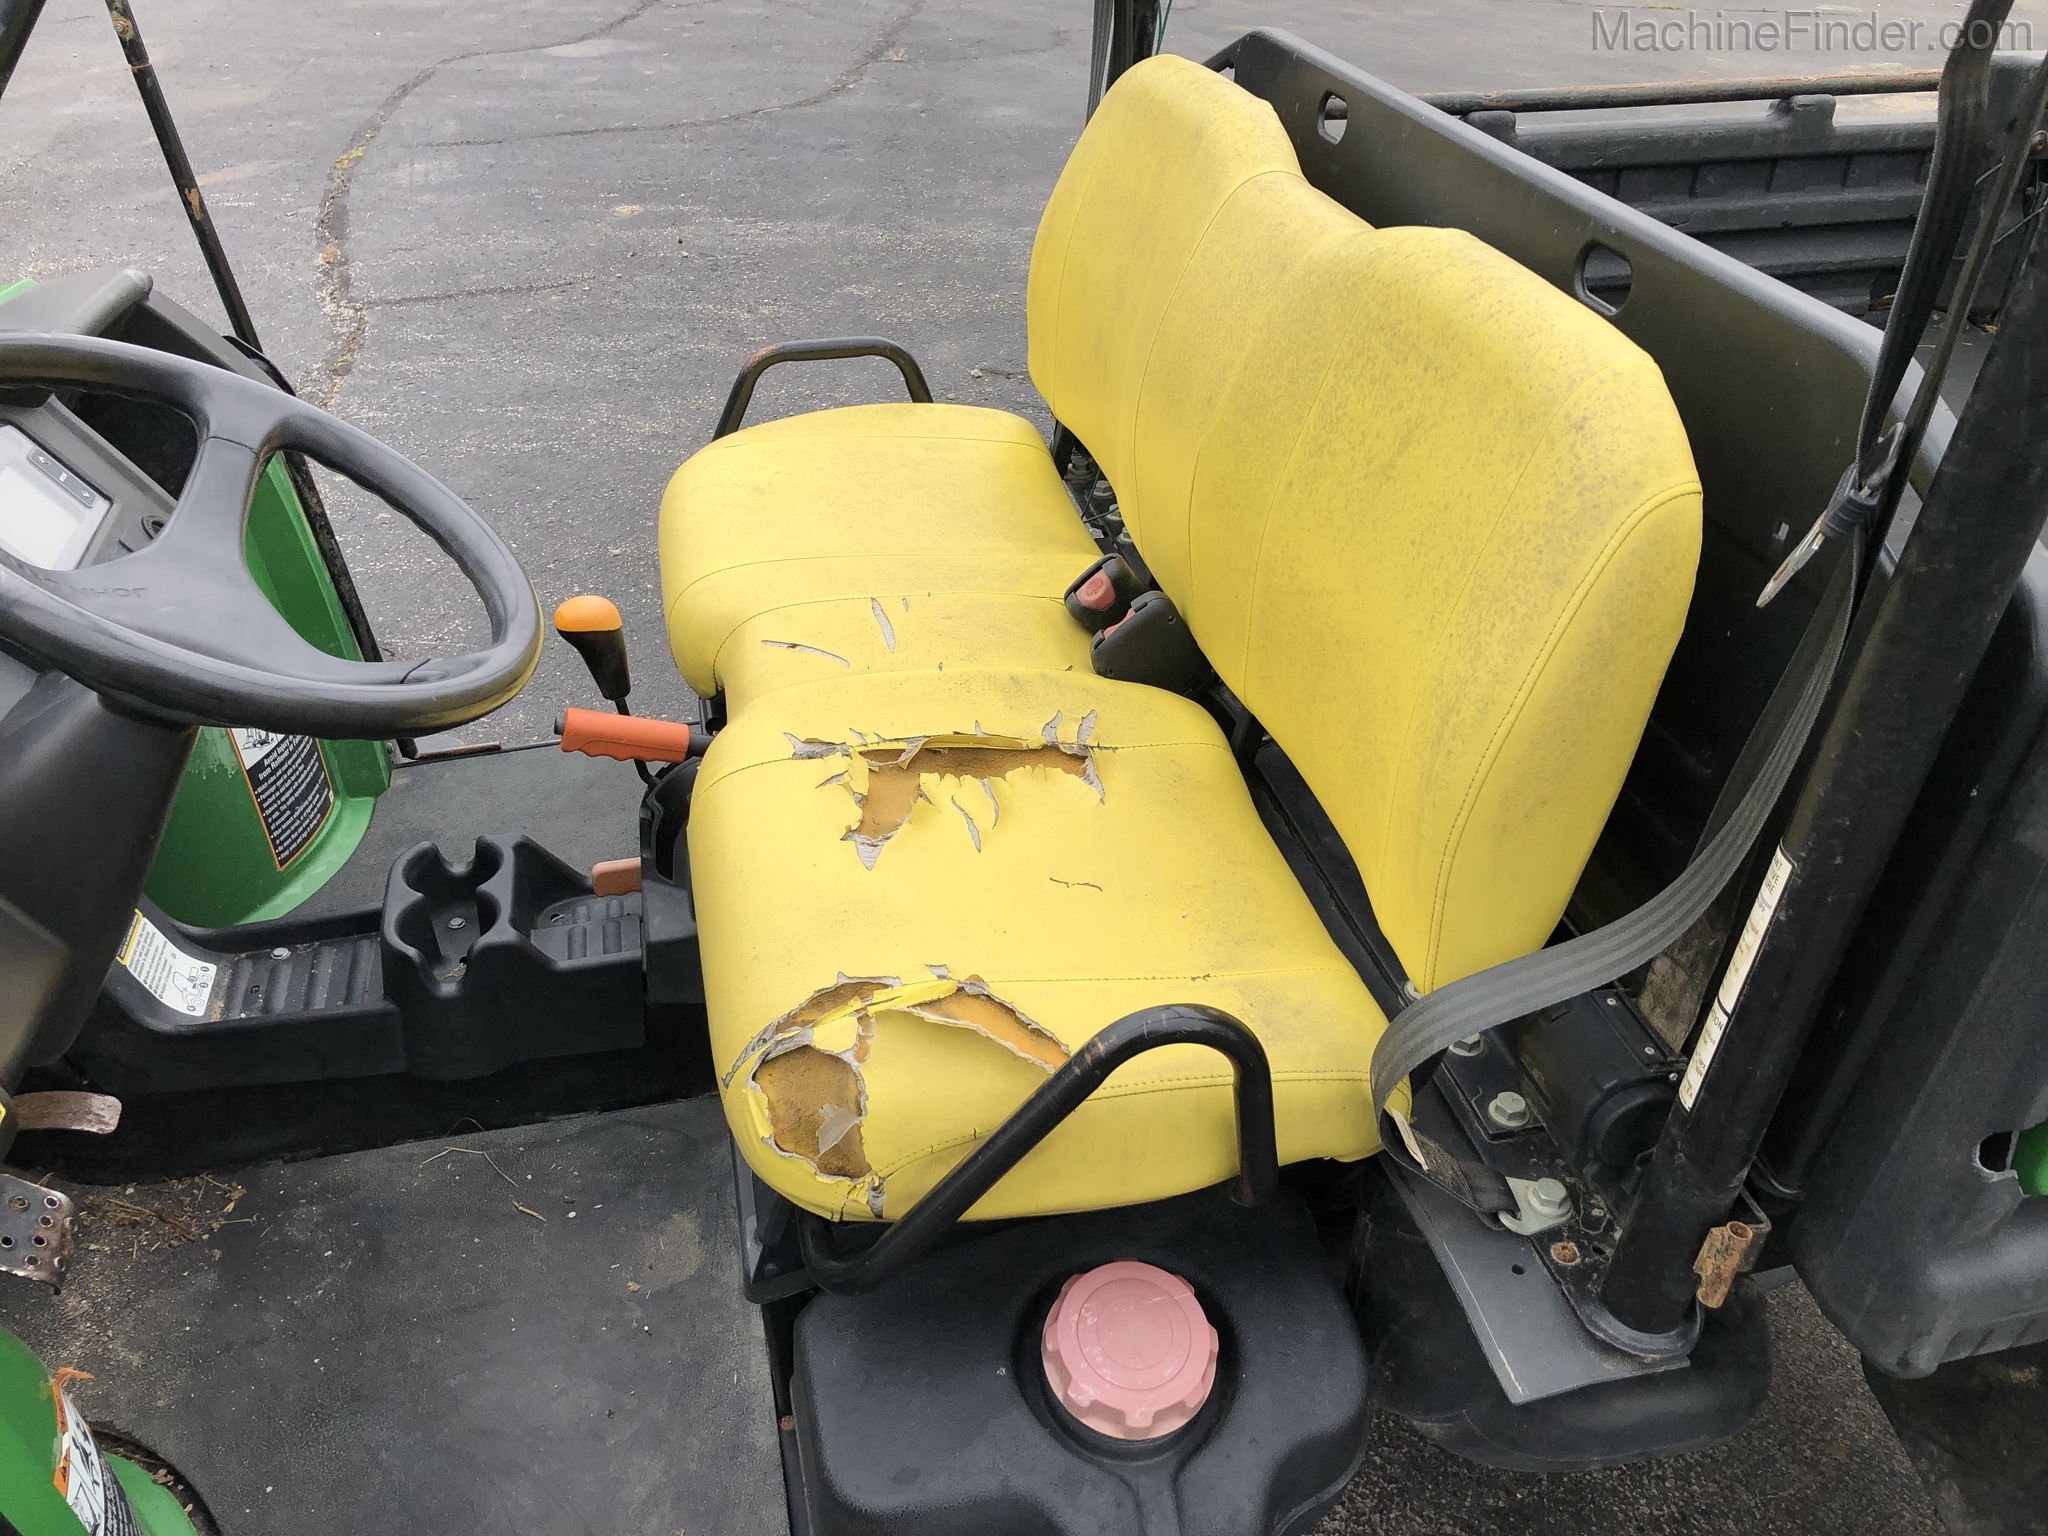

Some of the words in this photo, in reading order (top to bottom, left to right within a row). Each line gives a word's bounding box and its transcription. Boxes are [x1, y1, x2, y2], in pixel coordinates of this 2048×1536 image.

[259, 768, 271, 780] from
[271, 749, 289, 769] Rollover
[264, 751, 277, 766] Avoid
[277, 739, 289, 754] Injury
